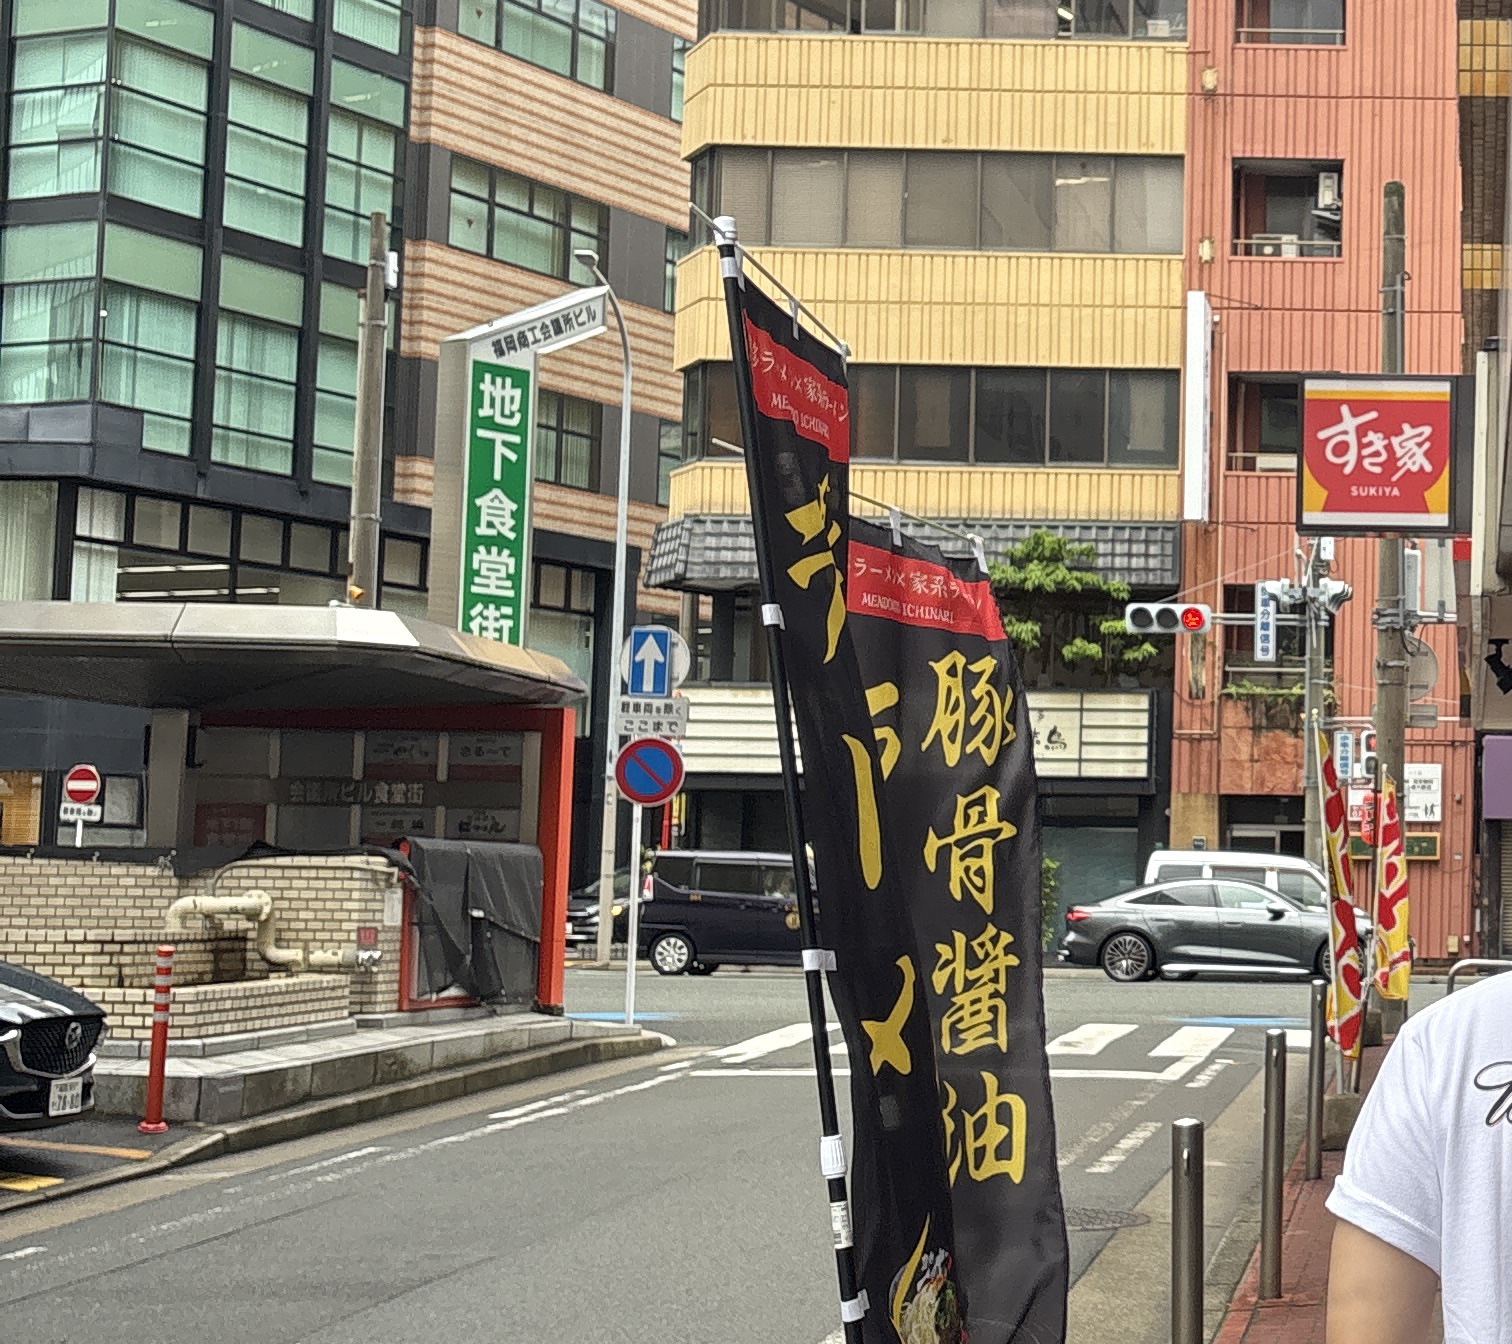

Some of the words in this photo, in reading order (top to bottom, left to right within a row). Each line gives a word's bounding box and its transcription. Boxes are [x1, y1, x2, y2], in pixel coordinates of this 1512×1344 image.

[491, 305, 597, 359] 福岡商工会議所ビル
[1317, 404, 1433, 482] すき家
[469, 372, 523, 646] 地下食堂街
[1350, 486, 1400, 497] SUKIYA
[623, 719, 679, 733] ここまで
